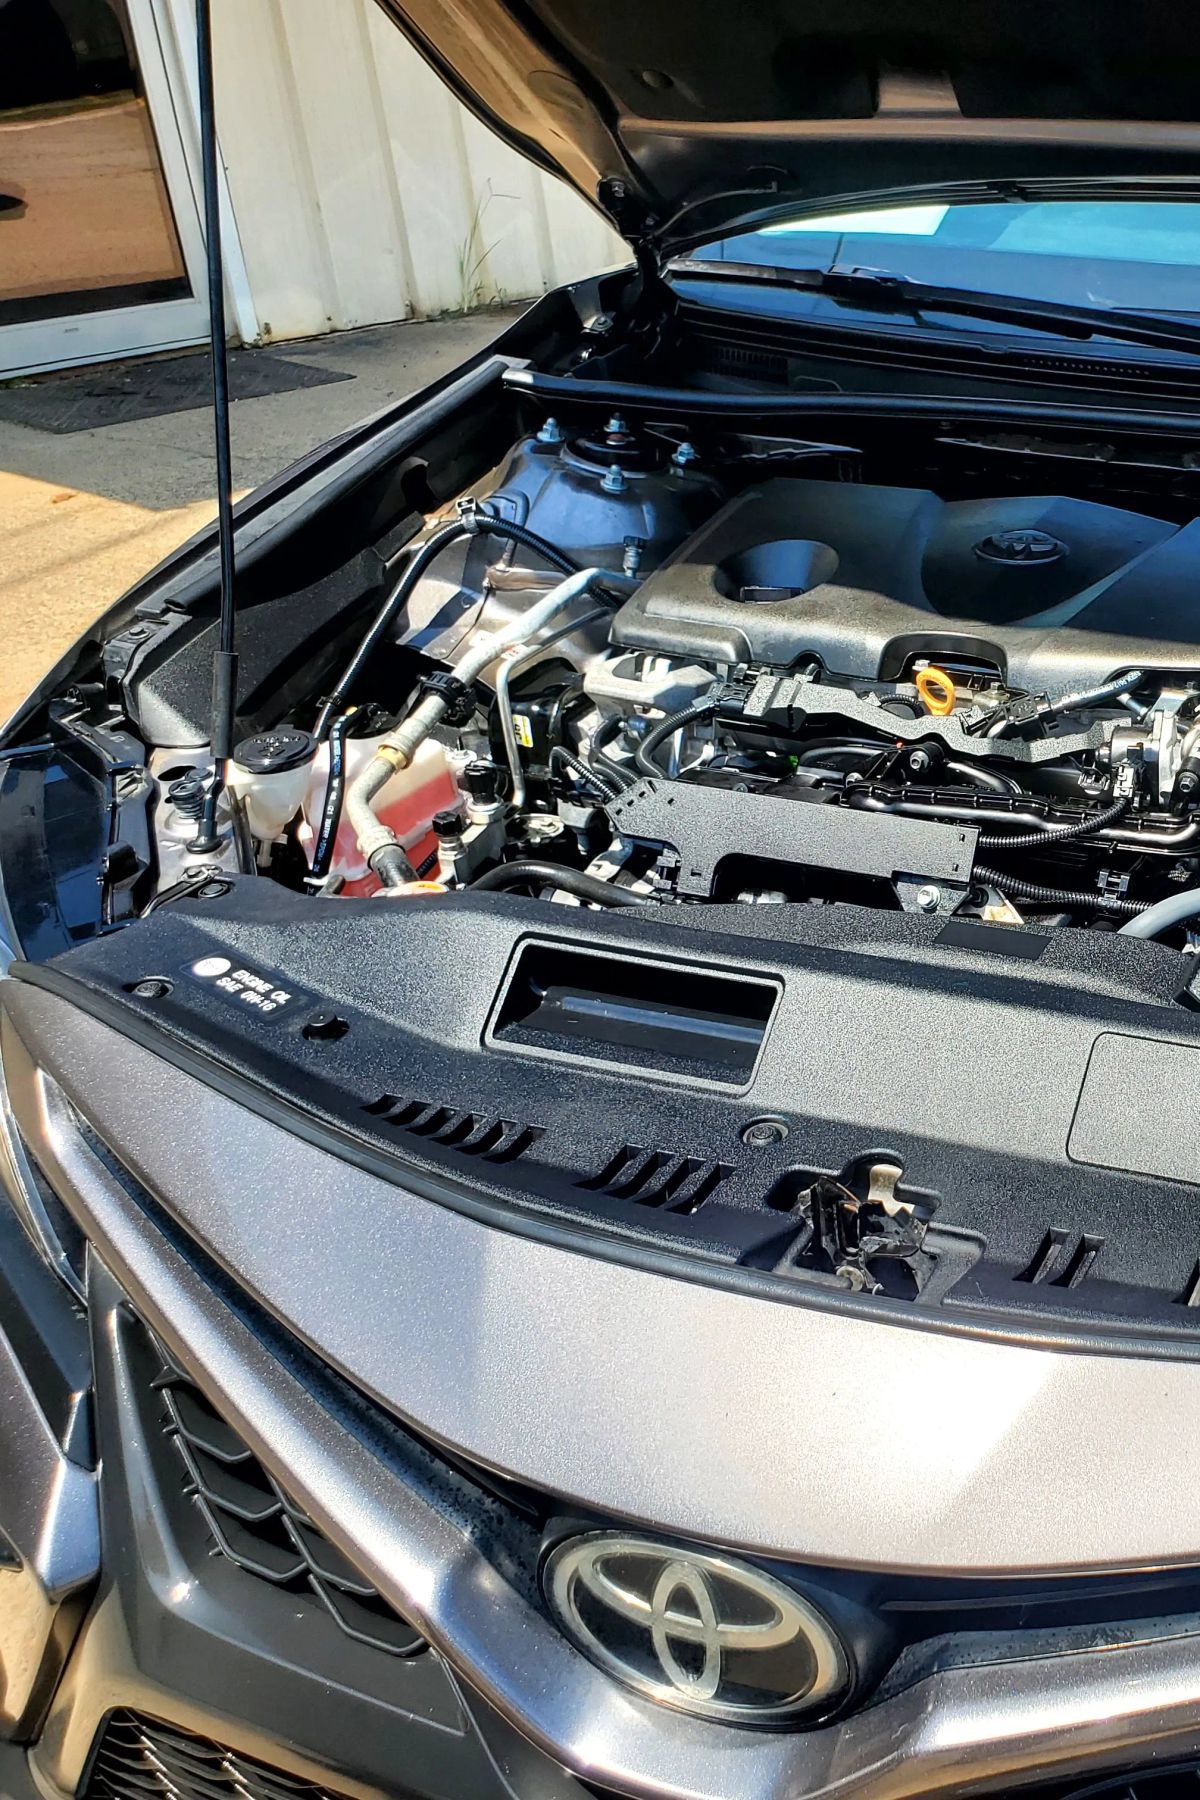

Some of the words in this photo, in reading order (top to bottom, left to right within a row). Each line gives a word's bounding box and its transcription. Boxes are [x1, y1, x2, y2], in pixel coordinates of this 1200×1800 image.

[216, 977, 244, 993] SAE
[240, 990, 277, 1011] 0W-16
[231, 969, 275, 993] ENGINE
[270, 990, 292, 1005] OIL
